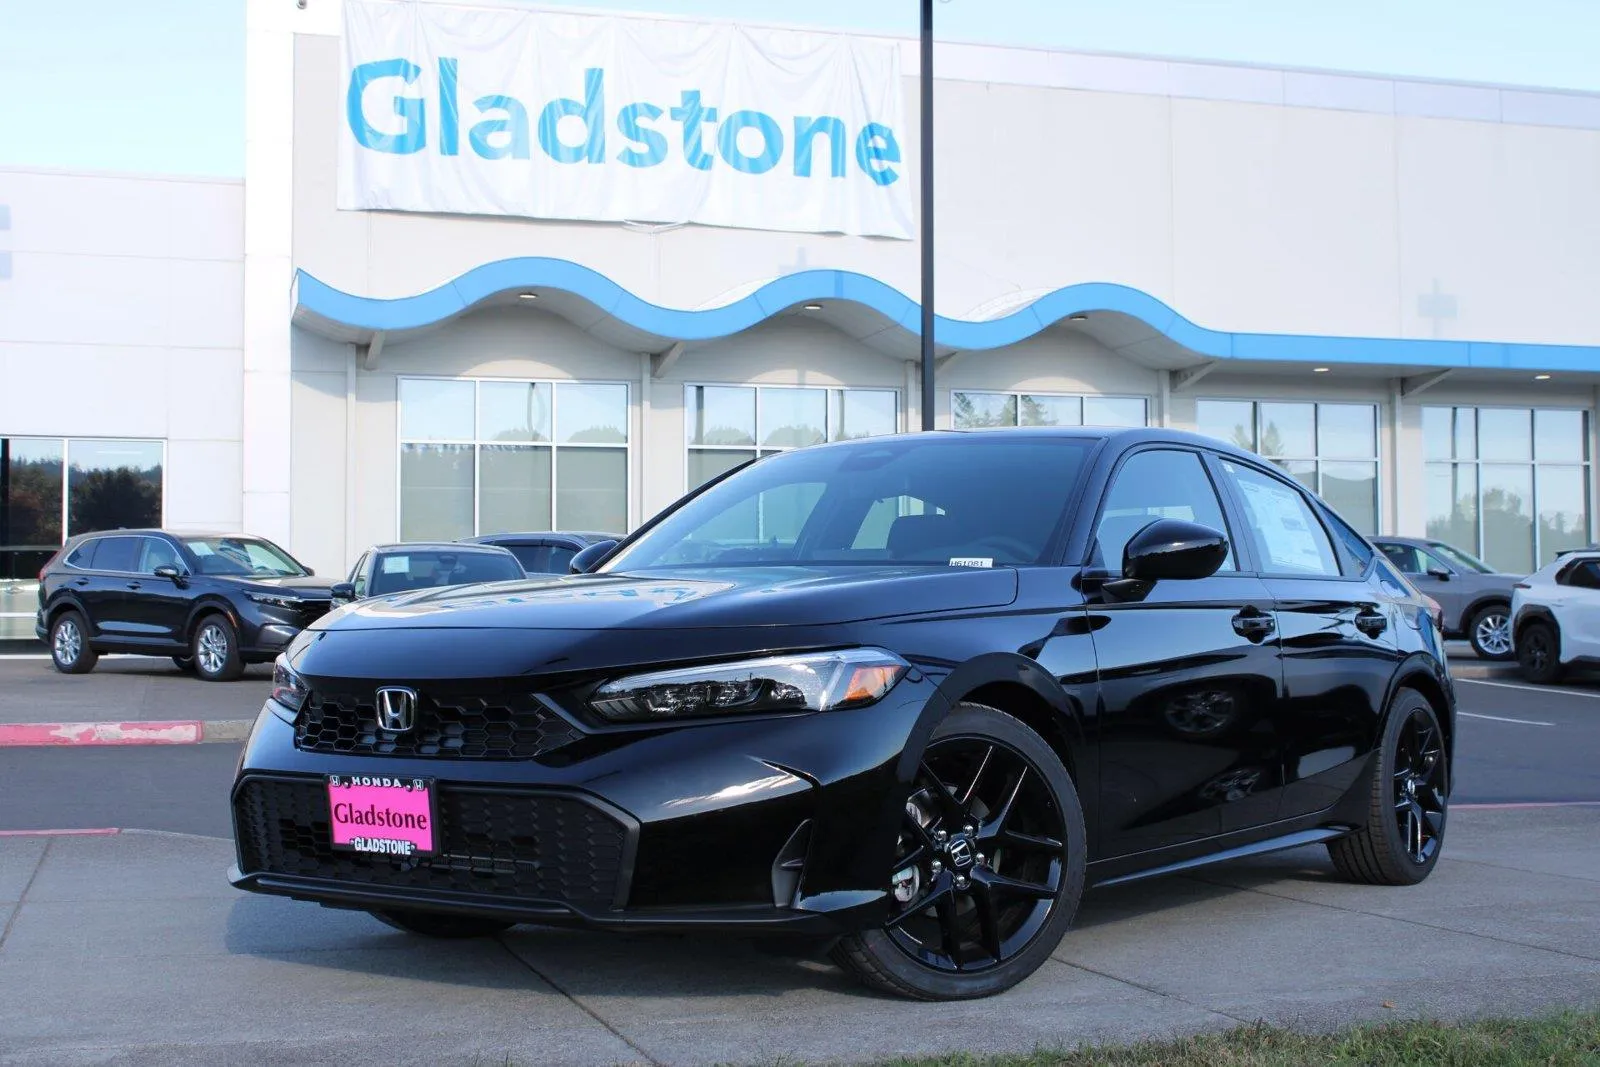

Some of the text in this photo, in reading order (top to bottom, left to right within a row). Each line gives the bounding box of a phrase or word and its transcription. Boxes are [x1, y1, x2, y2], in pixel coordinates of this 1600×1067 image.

[346, 56, 901, 186] Gladstone
[352, 776, 402, 788] HONDA
[333, 803, 427, 830] Gladstone
[354, 837, 411, 855] GLADSTONE
